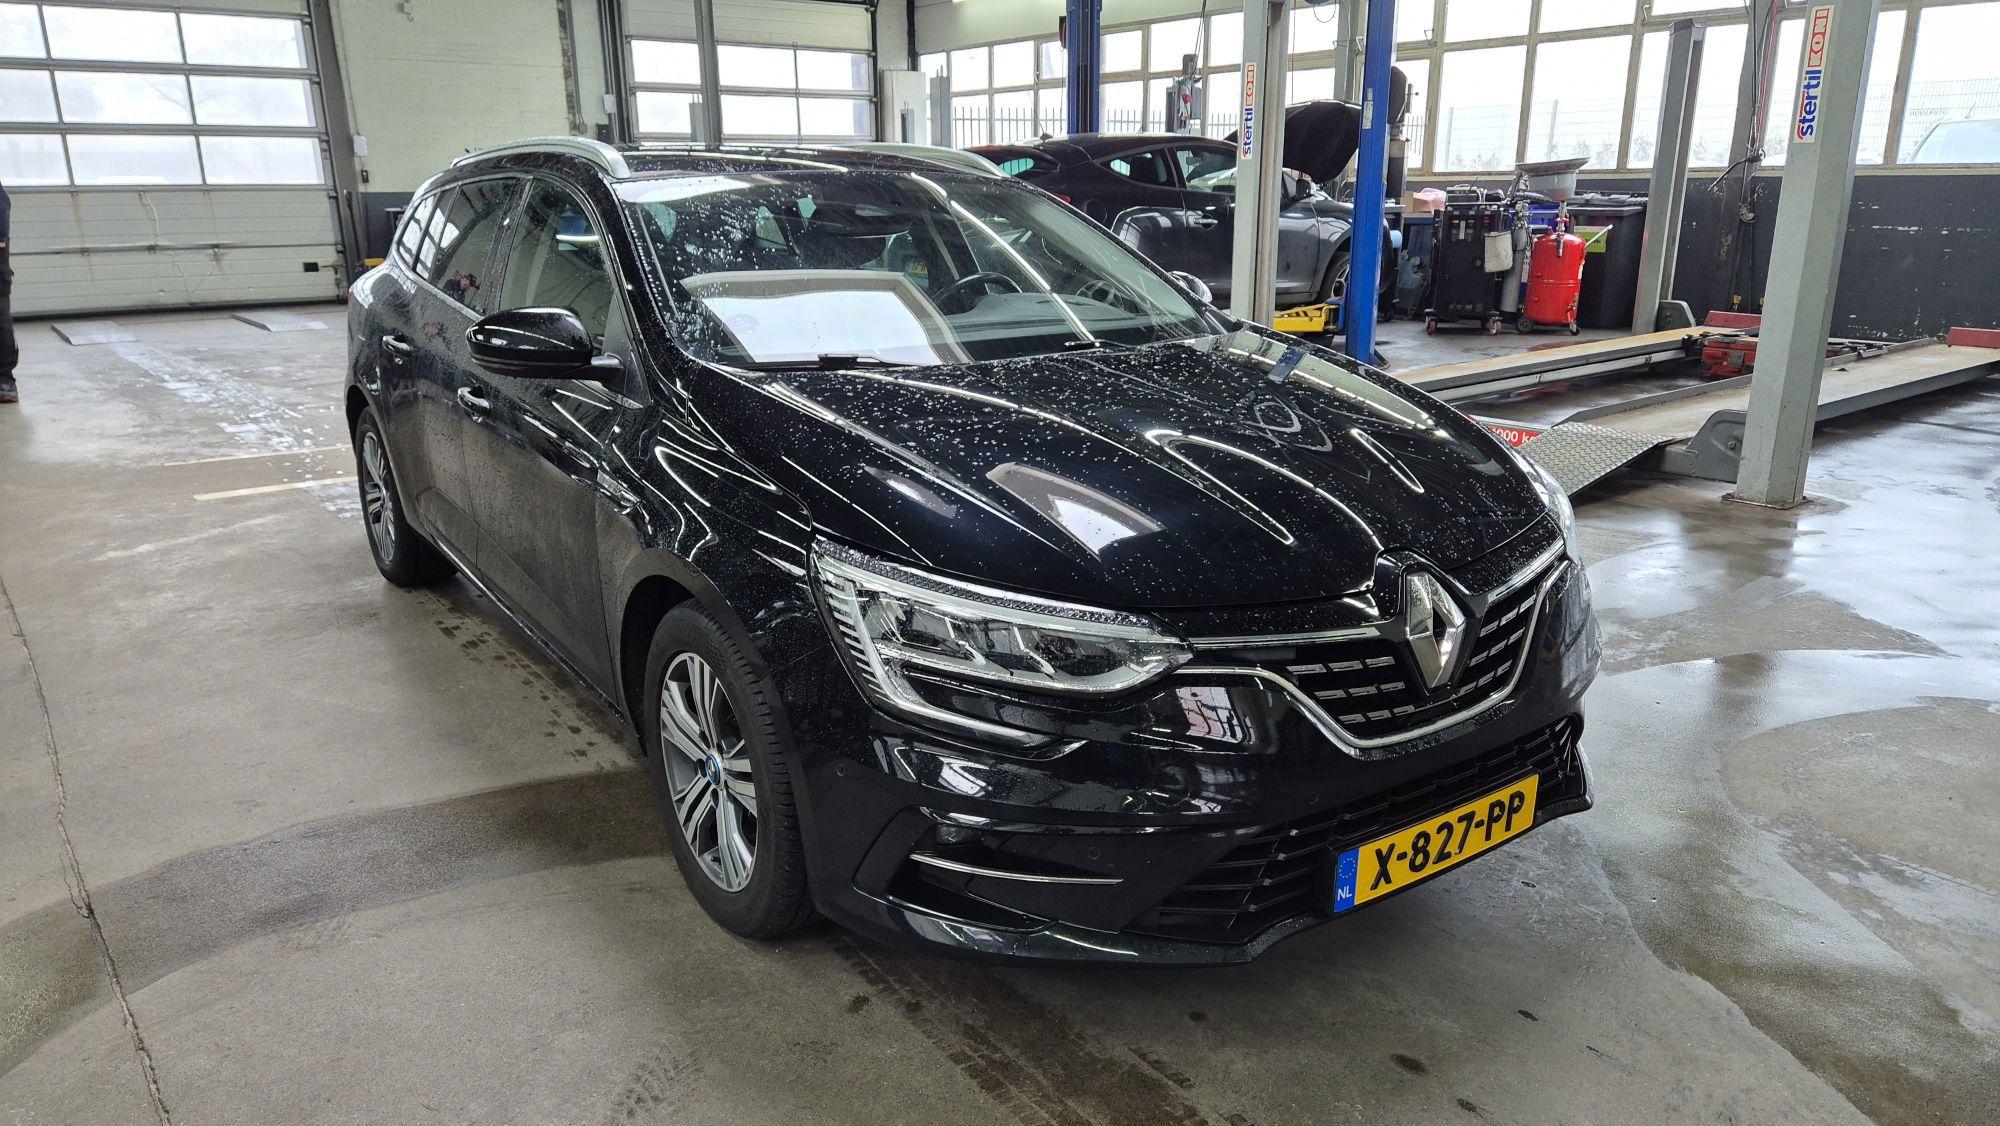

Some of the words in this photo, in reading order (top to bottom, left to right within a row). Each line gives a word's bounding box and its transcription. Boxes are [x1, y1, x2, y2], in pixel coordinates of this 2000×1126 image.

[1808, 8, 1829, 67] KONI
[1246, 64, 1254, 106] KONI
[1797, 69, 1821, 140] stertil
[1243, 107, 1253, 157] stertil
[1337, 886, 1353, 901] NL
[1370, 790, 1526, 890] X-827-PP
